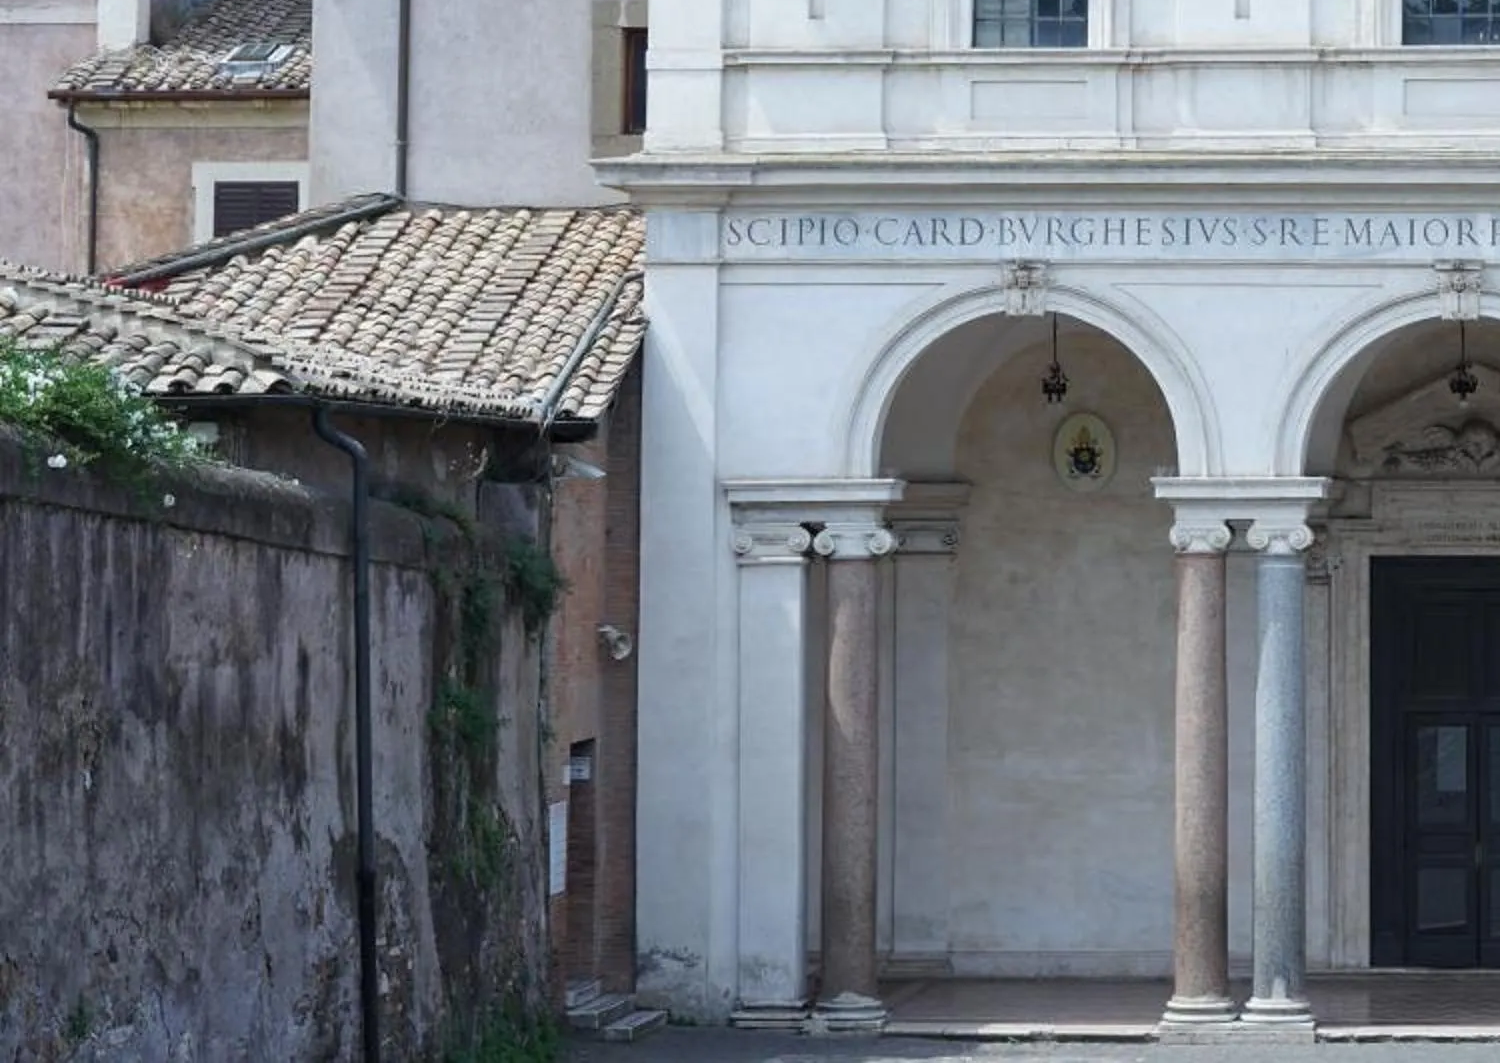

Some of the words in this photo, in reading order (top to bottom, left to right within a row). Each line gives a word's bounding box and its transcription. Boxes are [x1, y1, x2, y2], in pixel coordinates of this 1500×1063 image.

[727, 217, 859, 247] SCIPIO
[874, 217, 985, 247] CARD
[999, 217, 1238, 247] BVRGHESIVS
[1344, 217, 1479, 246] MAIOR
